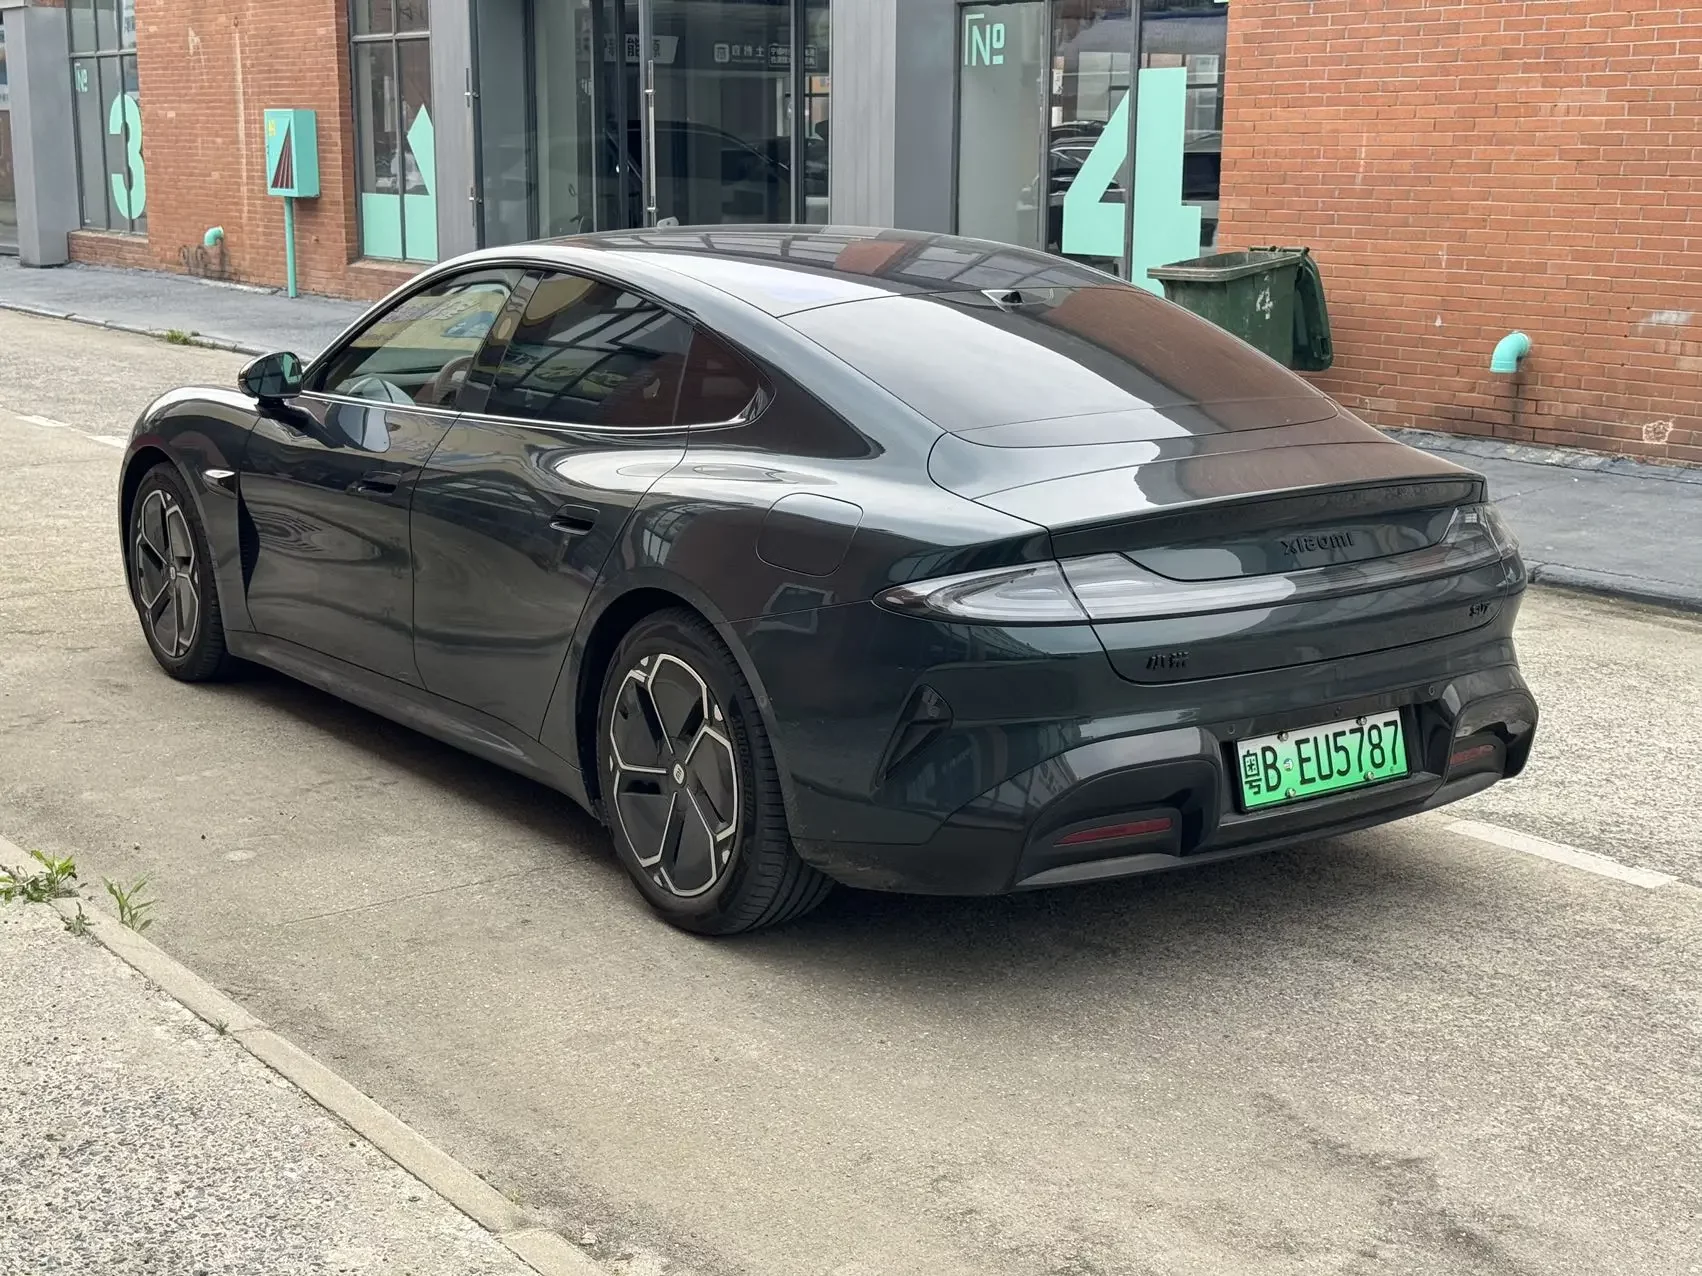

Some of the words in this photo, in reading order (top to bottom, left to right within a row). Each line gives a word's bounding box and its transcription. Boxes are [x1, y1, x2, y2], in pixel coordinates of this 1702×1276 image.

[109, 93, 146, 219] 3
[1062, 67, 1201, 298] 4
[1256, 287, 1273, 320] 4
